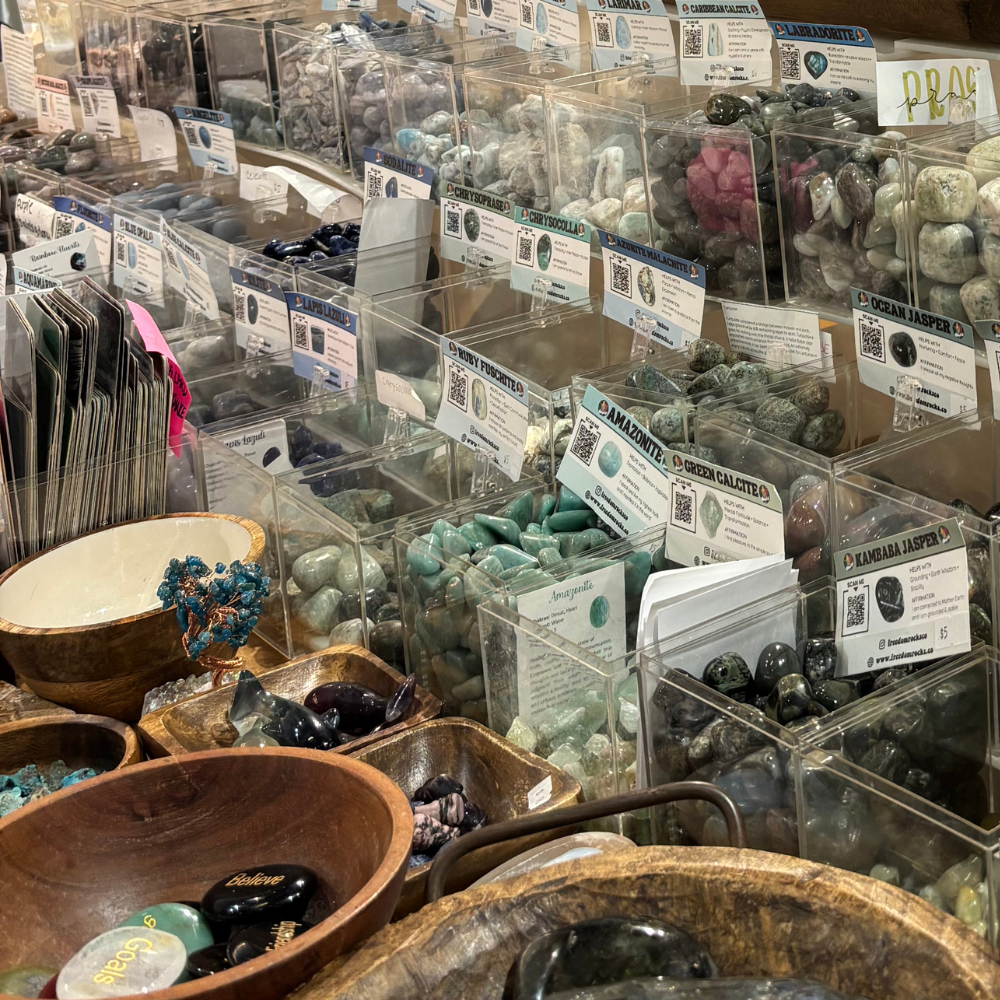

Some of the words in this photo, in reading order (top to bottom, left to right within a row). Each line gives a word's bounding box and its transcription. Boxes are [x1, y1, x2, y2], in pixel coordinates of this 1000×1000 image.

[691, 4, 725, 14] CARIBBEAN
[725, 4, 751, 14] CALCITE
[785, 25, 855, 42] LABRADORITE
[384, 155, 417, 176] SODALITE
[454, 186, 504, 212] CHRYSOPRASE
[529, 211, 579, 236] CHRYSOCOLLA
[616, 239, 648, 259] AZURITE
[649, 250, 689, 274] MALACHITE
[303, 298, 322, 316] LAPIS
[323, 306, 346, 325] LAZULI
[870, 296, 906, 321] OCEAN
[908, 307, 951, 335] JASPER
[458, 347, 480, 368] RUBY
[480, 359, 516, 393] FUSCHITE
[607, 407, 664, 463] AMAZONITE
[684, 461, 715, 482] GREEN
[716, 470, 759, 498] CALCITE
[855, 542, 902, 567] KAMBABA
[902, 531, 940, 554] JASPER
[548, 580, 594, 604] Amazonite
[939, 626, 949, 640] $5
[225, 872, 285, 887] Believe
[93, 936, 153, 987] Goals
